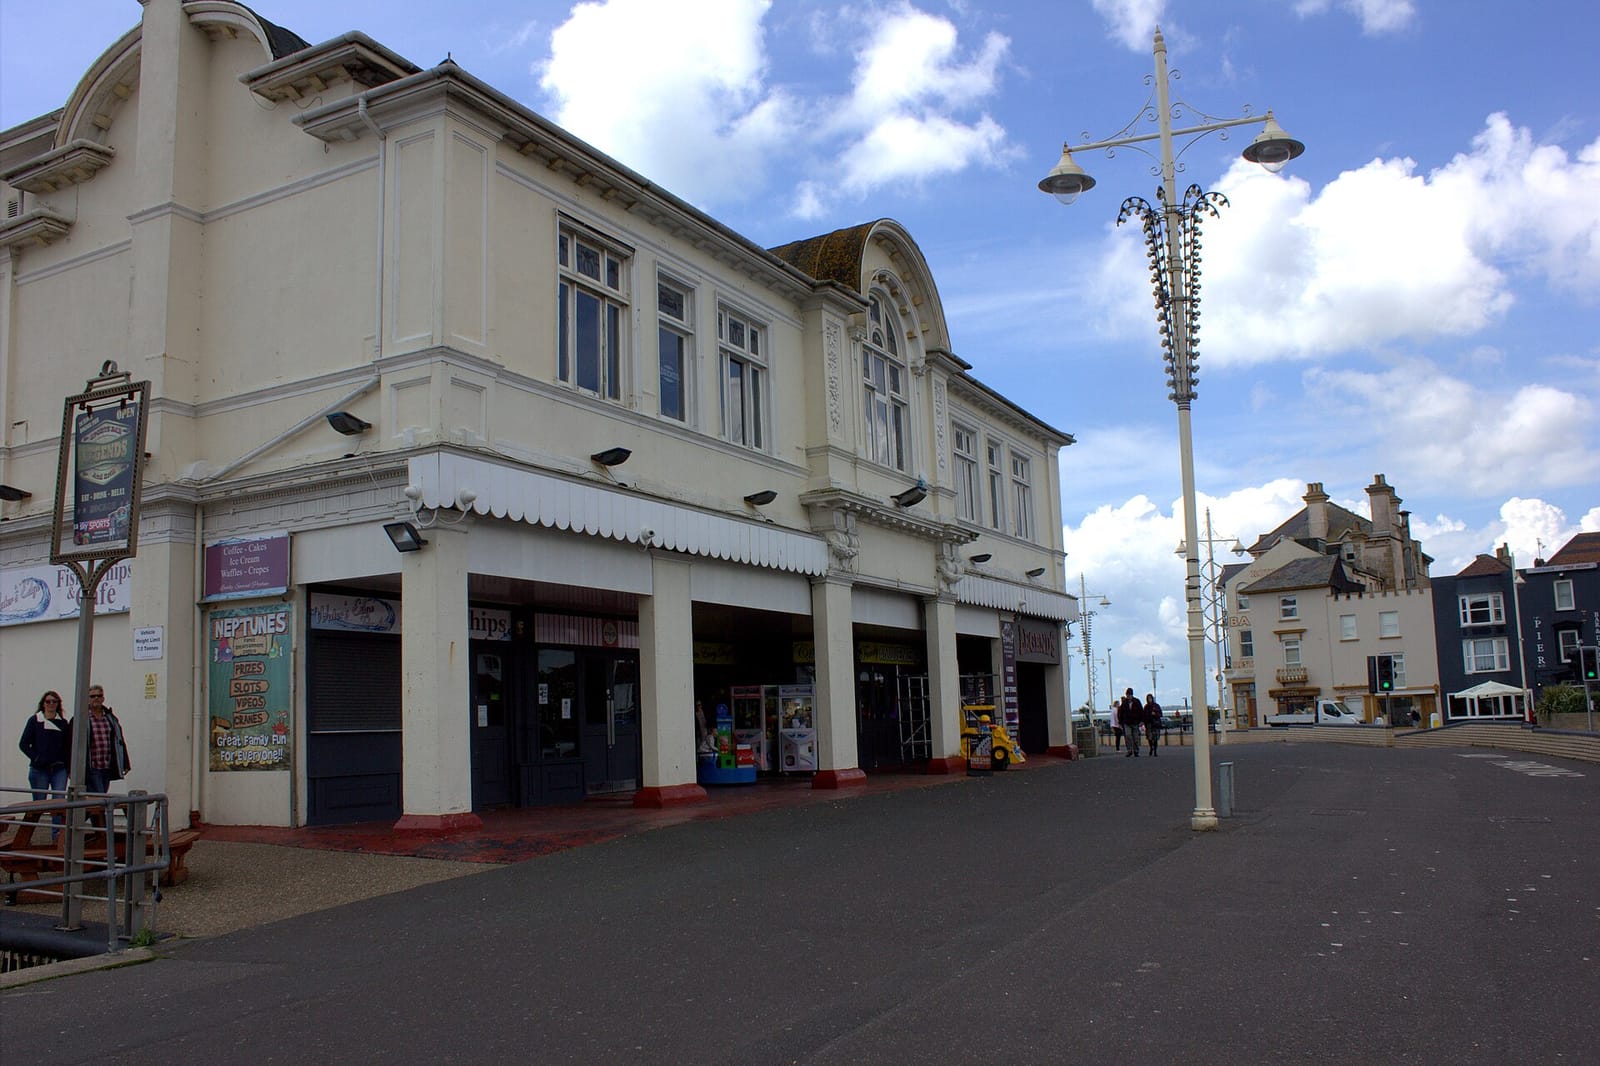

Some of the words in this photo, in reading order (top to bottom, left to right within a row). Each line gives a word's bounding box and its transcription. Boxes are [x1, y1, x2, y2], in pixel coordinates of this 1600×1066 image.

[89, 518, 111, 531] SPORTS
[223, 546, 244, 556] Coffee
[248, 543, 267, 553] Cakes
[229, 557, 239, 566] Ice
[240, 555, 260, 565] Cream
[56, 568, 79, 588] Fis
[221, 568, 243, 578] Waffles
[248, 566, 270, 576] Crepes
[66, 587, 75, 600] &
[75, 582, 116, 607] Cfé
[215, 612, 287, 639] NEPTUNES
[1534, 619, 1546, 664] PIER
[235, 662, 263, 675] PRIZES
[234, 681, 261, 693] SLOTS
[236, 697, 264, 708] VIDEOS
[234, 713, 263, 726] CRANES
[217, 734, 242, 747] Great
[244, 734, 270, 747] Family
[272, 734, 287, 745] Fun
[220, 750, 236, 762] For
[237, 748, 283, 762] Everyone!!
